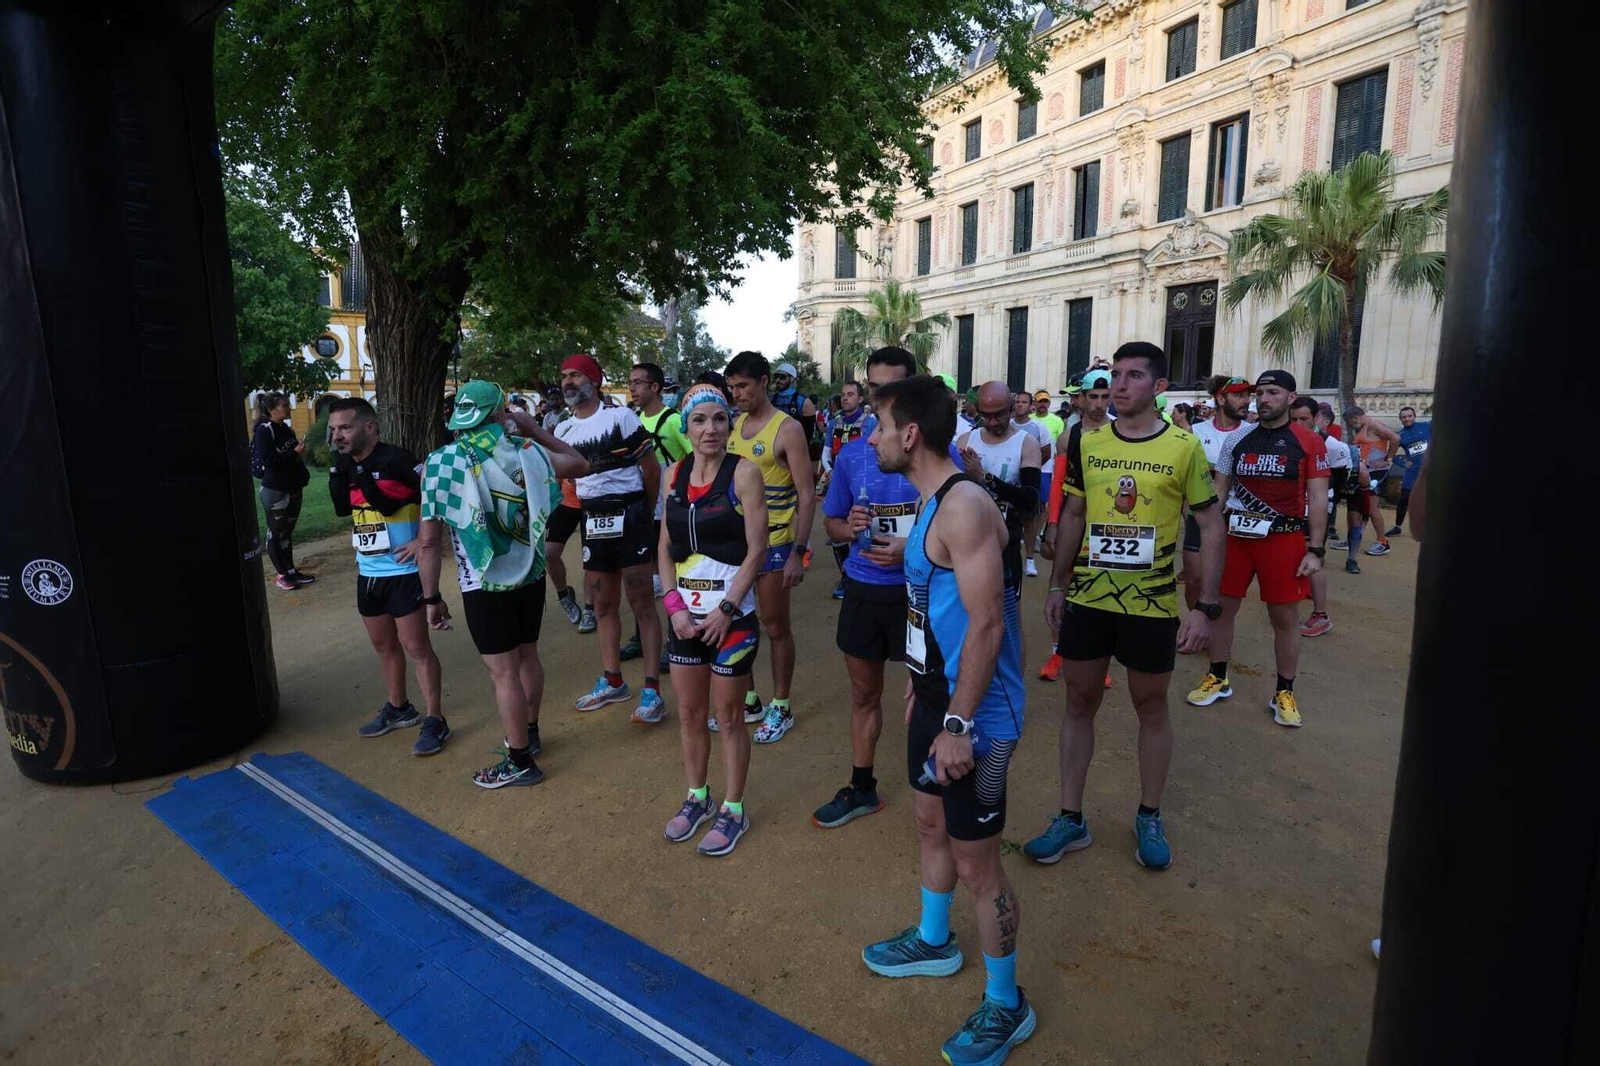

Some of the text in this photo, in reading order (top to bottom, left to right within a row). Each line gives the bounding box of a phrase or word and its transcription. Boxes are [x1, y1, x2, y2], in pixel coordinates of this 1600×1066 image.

[1088, 456, 1174, 476] Paparunners
[593, 517, 615, 529] 185
[879, 518, 897, 533] 51
[1237, 516, 1261, 528] 157
[1106, 525, 1137, 537] Sherry
[358, 533, 377, 546] 197
[1100, 538, 1139, 557] 232
[25, 561, 67, 577] WILLIAMS
[26, 586, 70, 603] HUMBERT
[690, 591, 702, 607] 2
